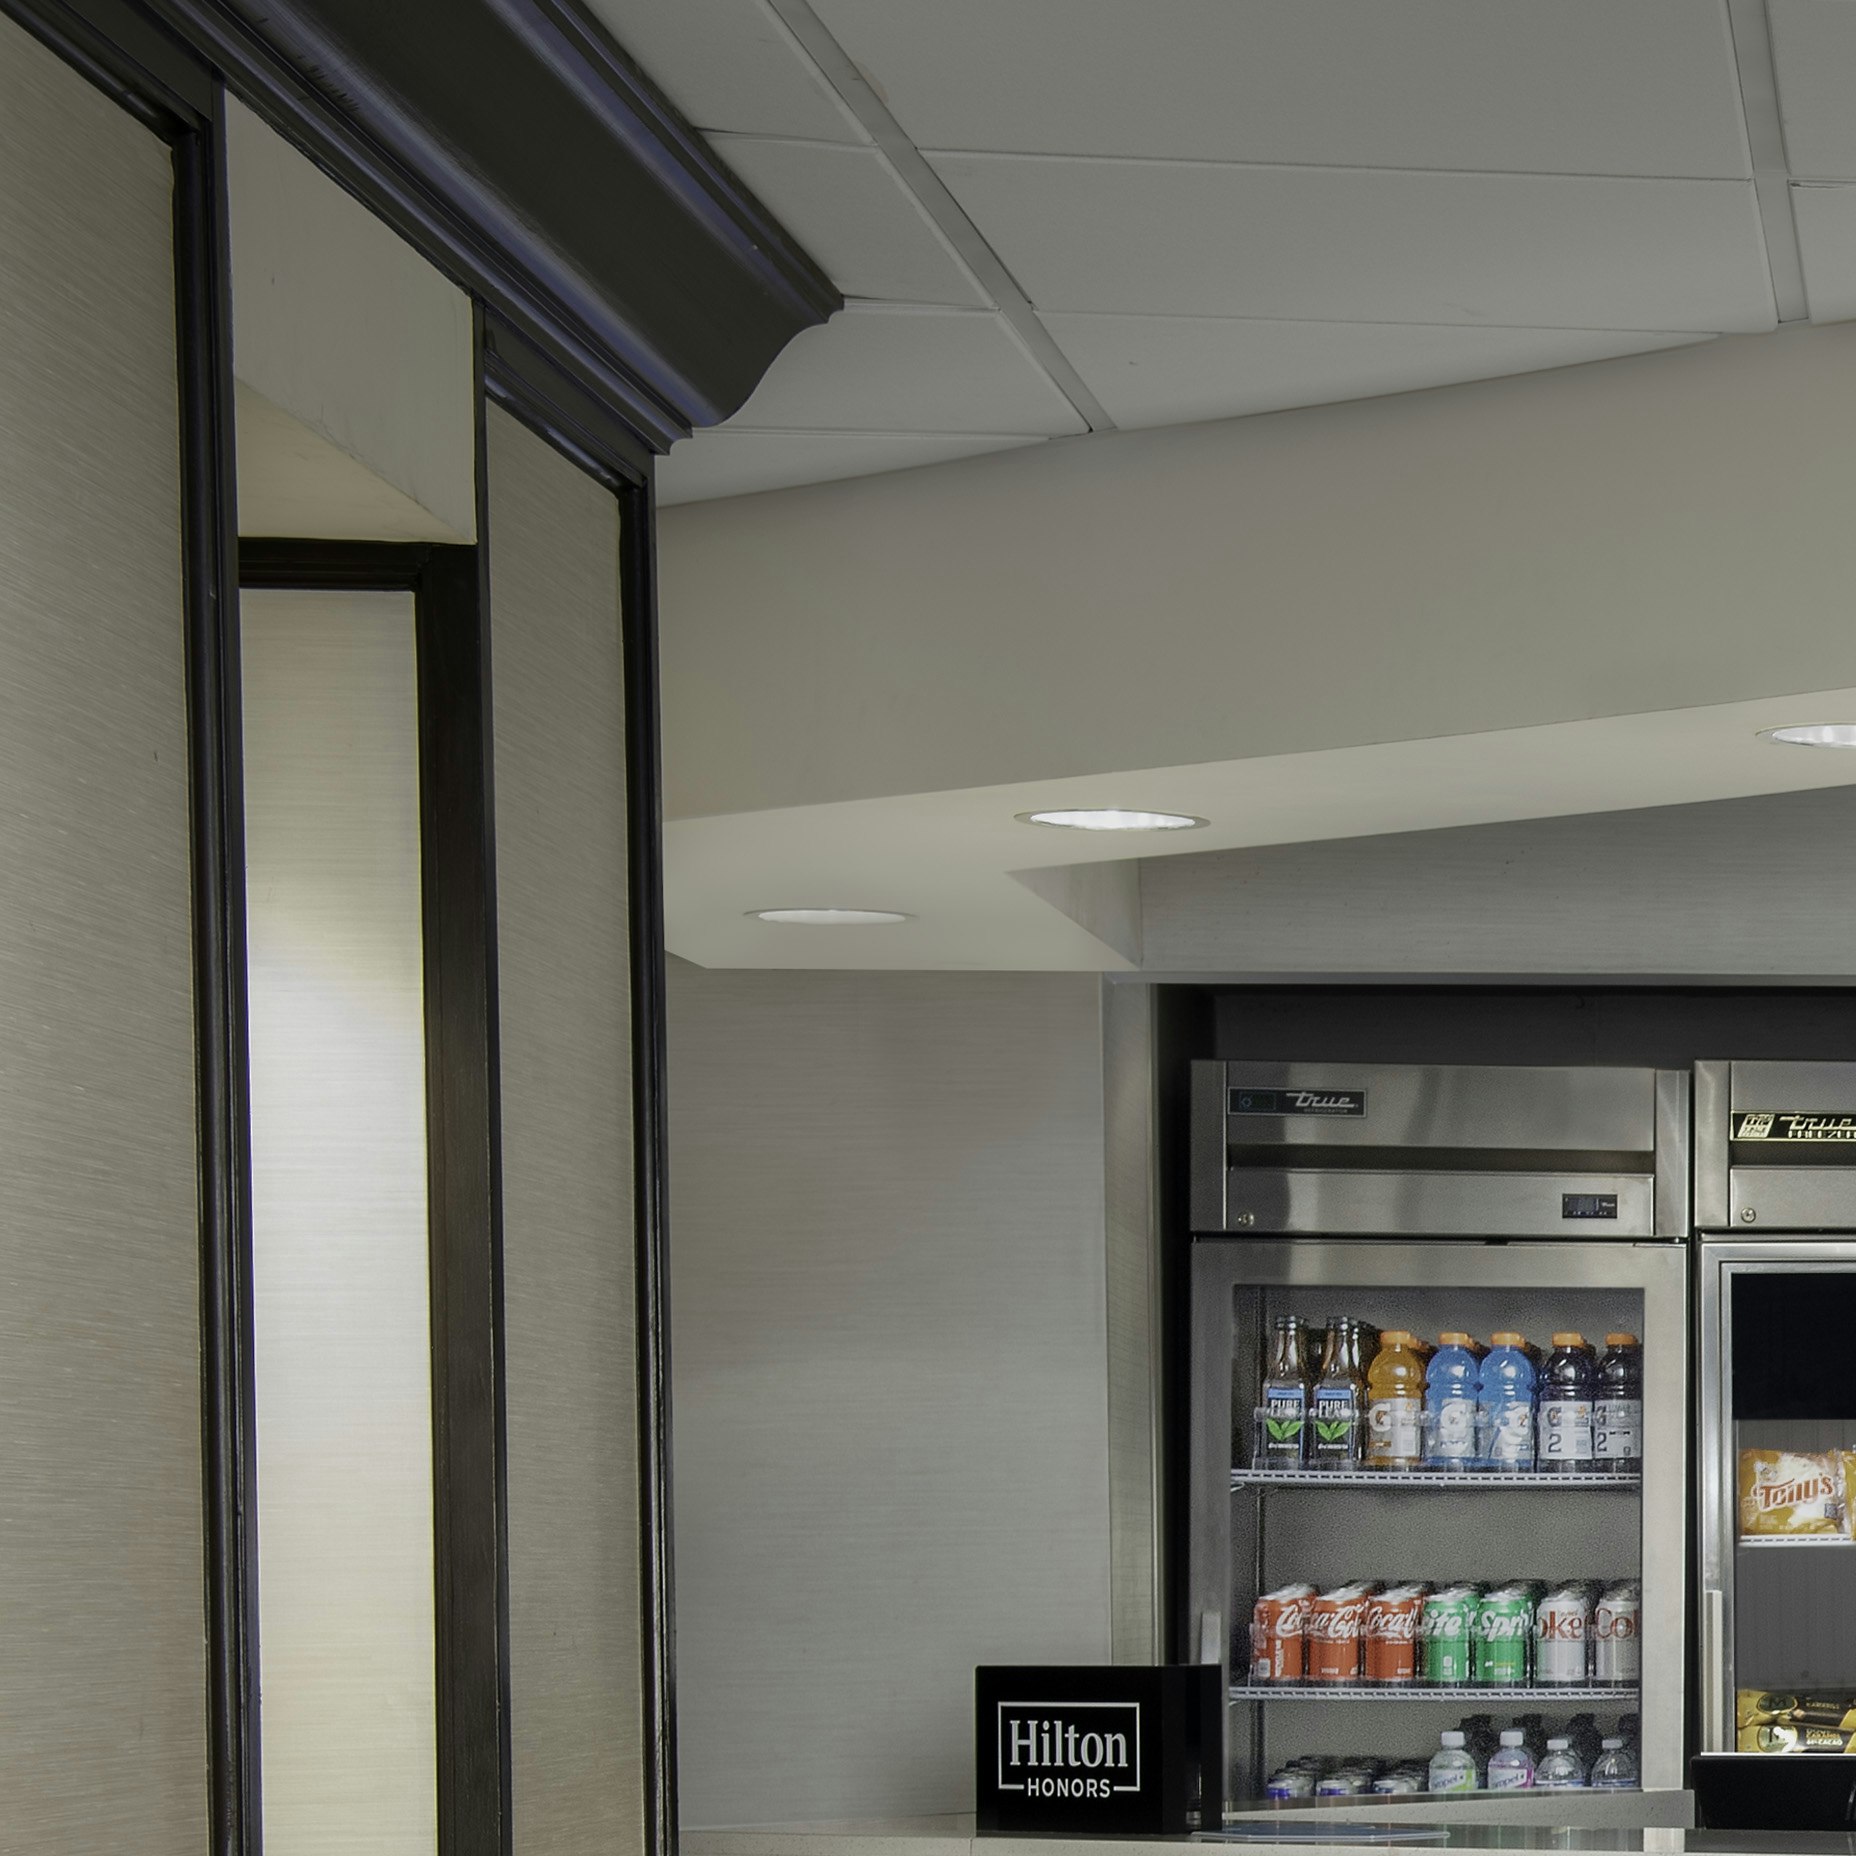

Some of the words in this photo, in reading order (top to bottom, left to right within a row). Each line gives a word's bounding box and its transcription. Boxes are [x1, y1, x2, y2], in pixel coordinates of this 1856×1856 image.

[1271, 1399, 1300, 1408] PURE
[1318, 1400, 1348, 1409] PURE
[1548, 1433, 1562, 1453] 2
[1537, 1611, 1582, 1639] oke
[1009, 1720, 1129, 1768] Hilton
[1027, 1777, 1111, 1798] HONORS
